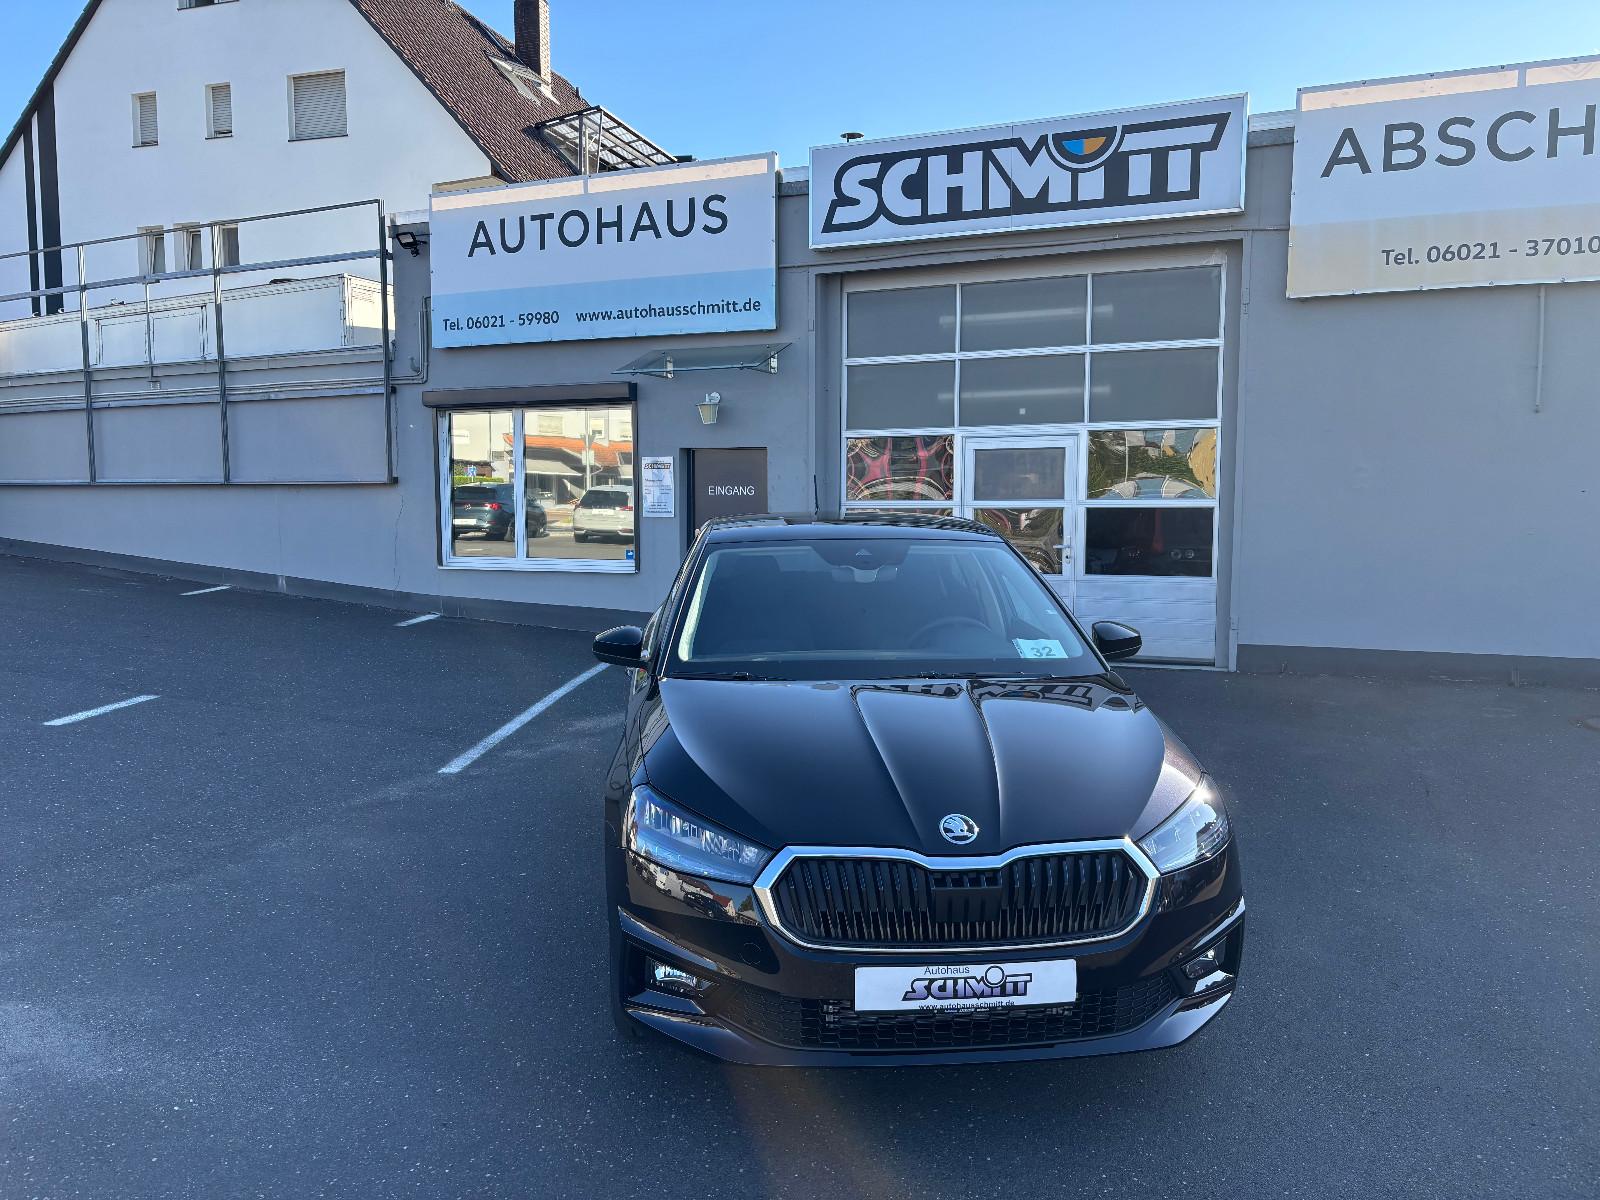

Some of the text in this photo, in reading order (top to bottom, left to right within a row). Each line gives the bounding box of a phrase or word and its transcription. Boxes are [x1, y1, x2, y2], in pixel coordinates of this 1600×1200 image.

[1320, 104, 1597, 178] ABSCH
[821, 112, 1231, 233] SCHMITT
[468, 194, 728, 257] AUTOHAUS
[1381, 248, 1420, 266] Tel.
[1426, 242, 1500, 264] 06021
[1525, 235, 1600, 257] 37010
[443, 318, 463, 331] Tel.
[466, 314, 506, 330] 06021
[518, 311, 560, 326] 59980
[575, 298, 761, 322] www.autohausschmitt.de
[708, 485, 755, 496] EINGANG
[1030, 646, 1056, 657] 32
[902, 965, 1033, 1001] SCHMITT
[924, 965, 970, 976] Autohaus
[918, 1000, 1015, 1010] www.autohausschmitt.de
